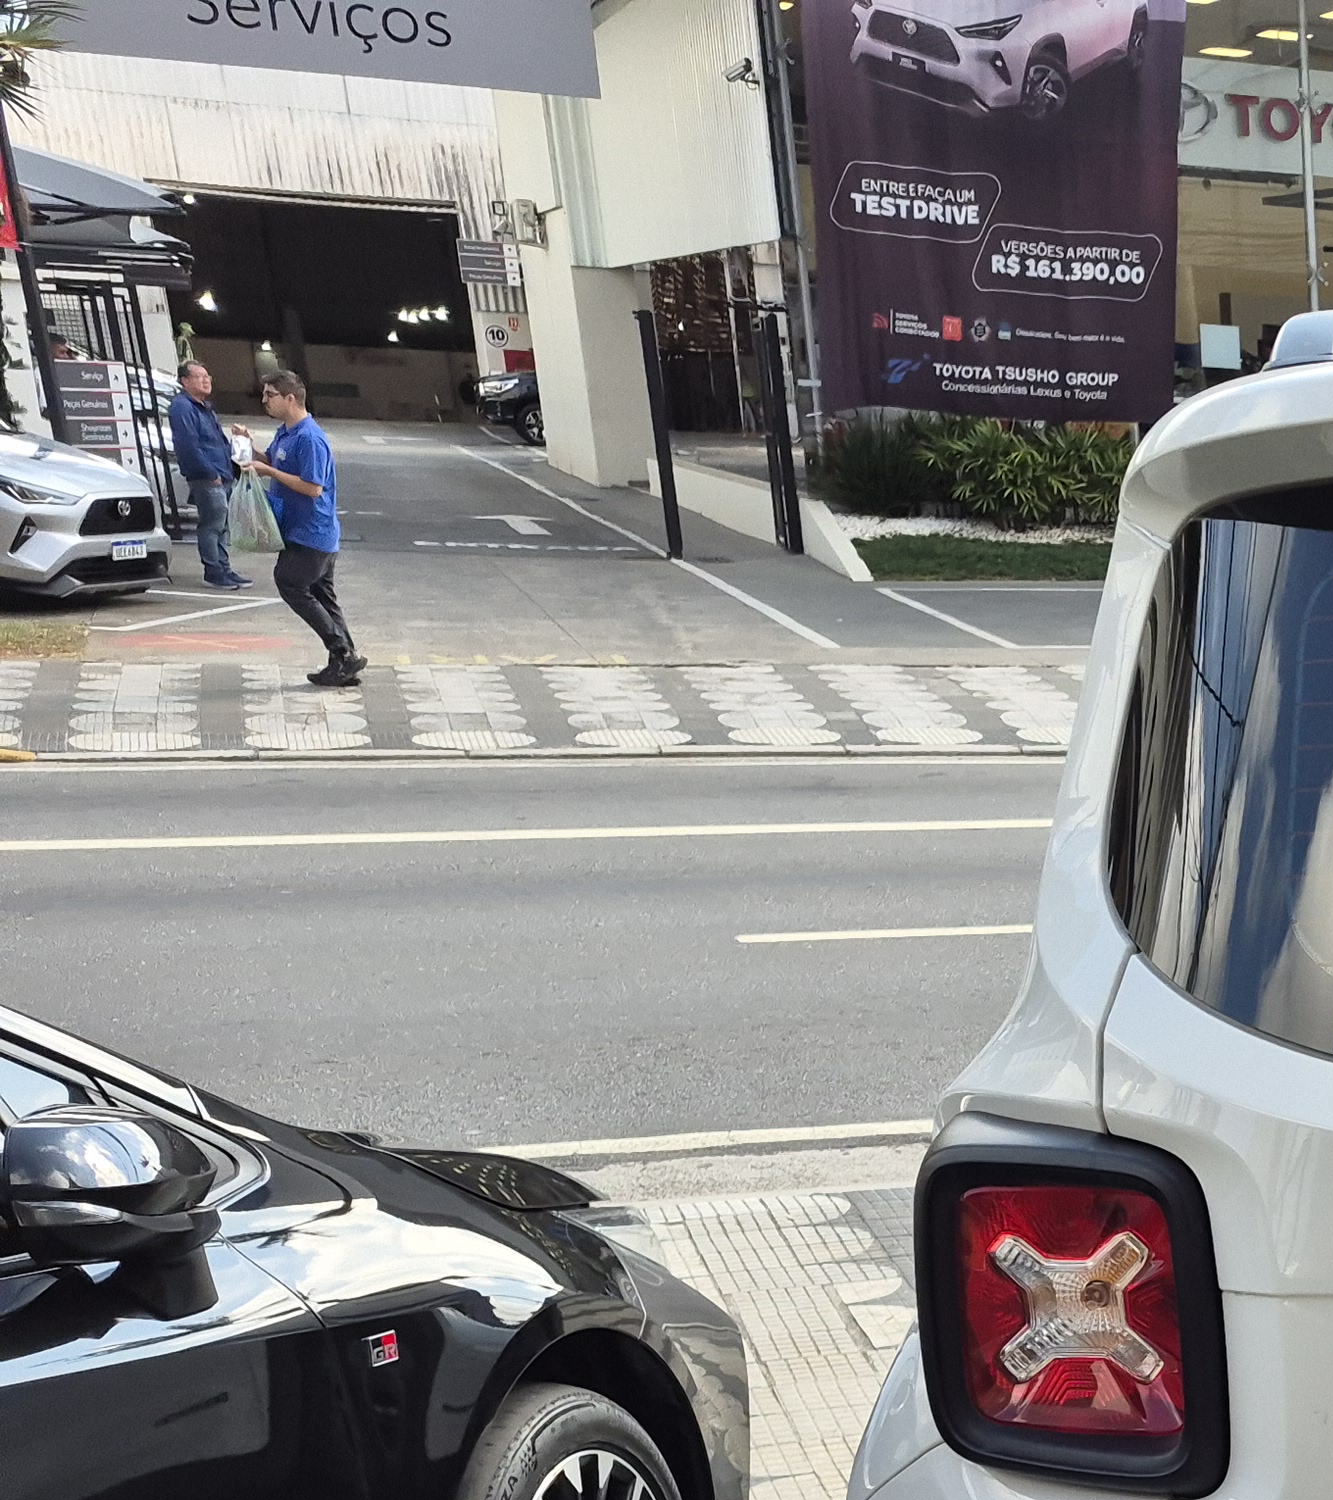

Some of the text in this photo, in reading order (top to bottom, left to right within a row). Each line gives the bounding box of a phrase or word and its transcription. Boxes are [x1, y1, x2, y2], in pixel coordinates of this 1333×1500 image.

[861, 178, 975, 204] ENTRE E FAÇA UM
[850, 191, 980, 225] TEST DRIVE
[1000, 240, 1140, 263] VERSÕES A PARTIR DE
[991, 254, 1145, 285] R$ 161.390,00
[488, 329, 505, 341] 10
[933, 362, 1119, 387] TOYOTA TSUSHO GROUP
[941, 380, 1108, 402] Concessionárias Lexus e Toyota
